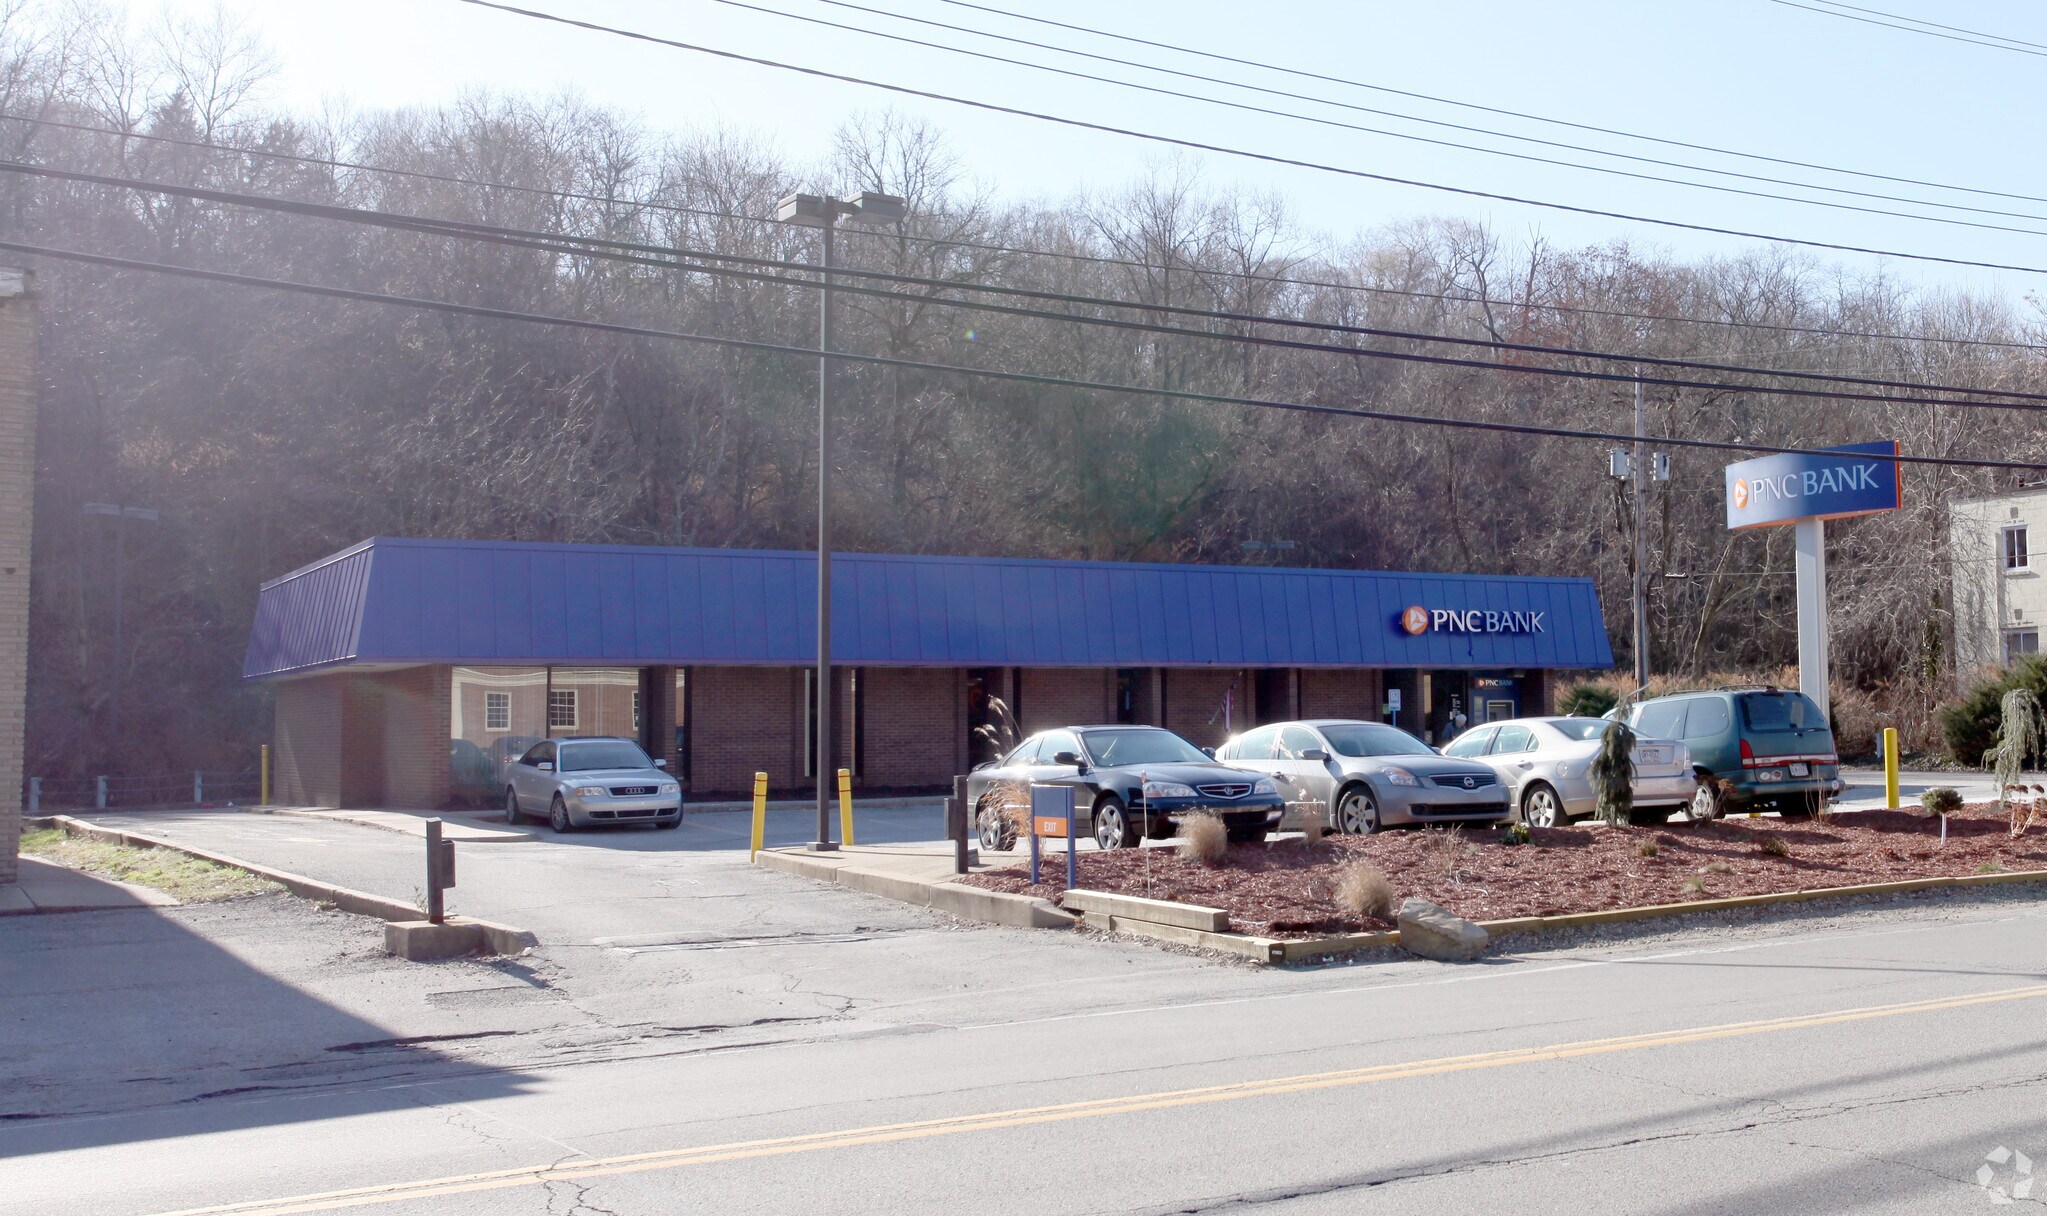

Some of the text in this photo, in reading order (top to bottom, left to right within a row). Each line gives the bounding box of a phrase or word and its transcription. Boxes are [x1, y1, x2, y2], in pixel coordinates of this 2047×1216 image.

[1751, 463, 1879, 504] PNC BANK
[1431, 609, 1545, 633] PNC BANK
[1485, 679, 1499, 687] PNC
[1043, 821, 1057, 833] EXIT
